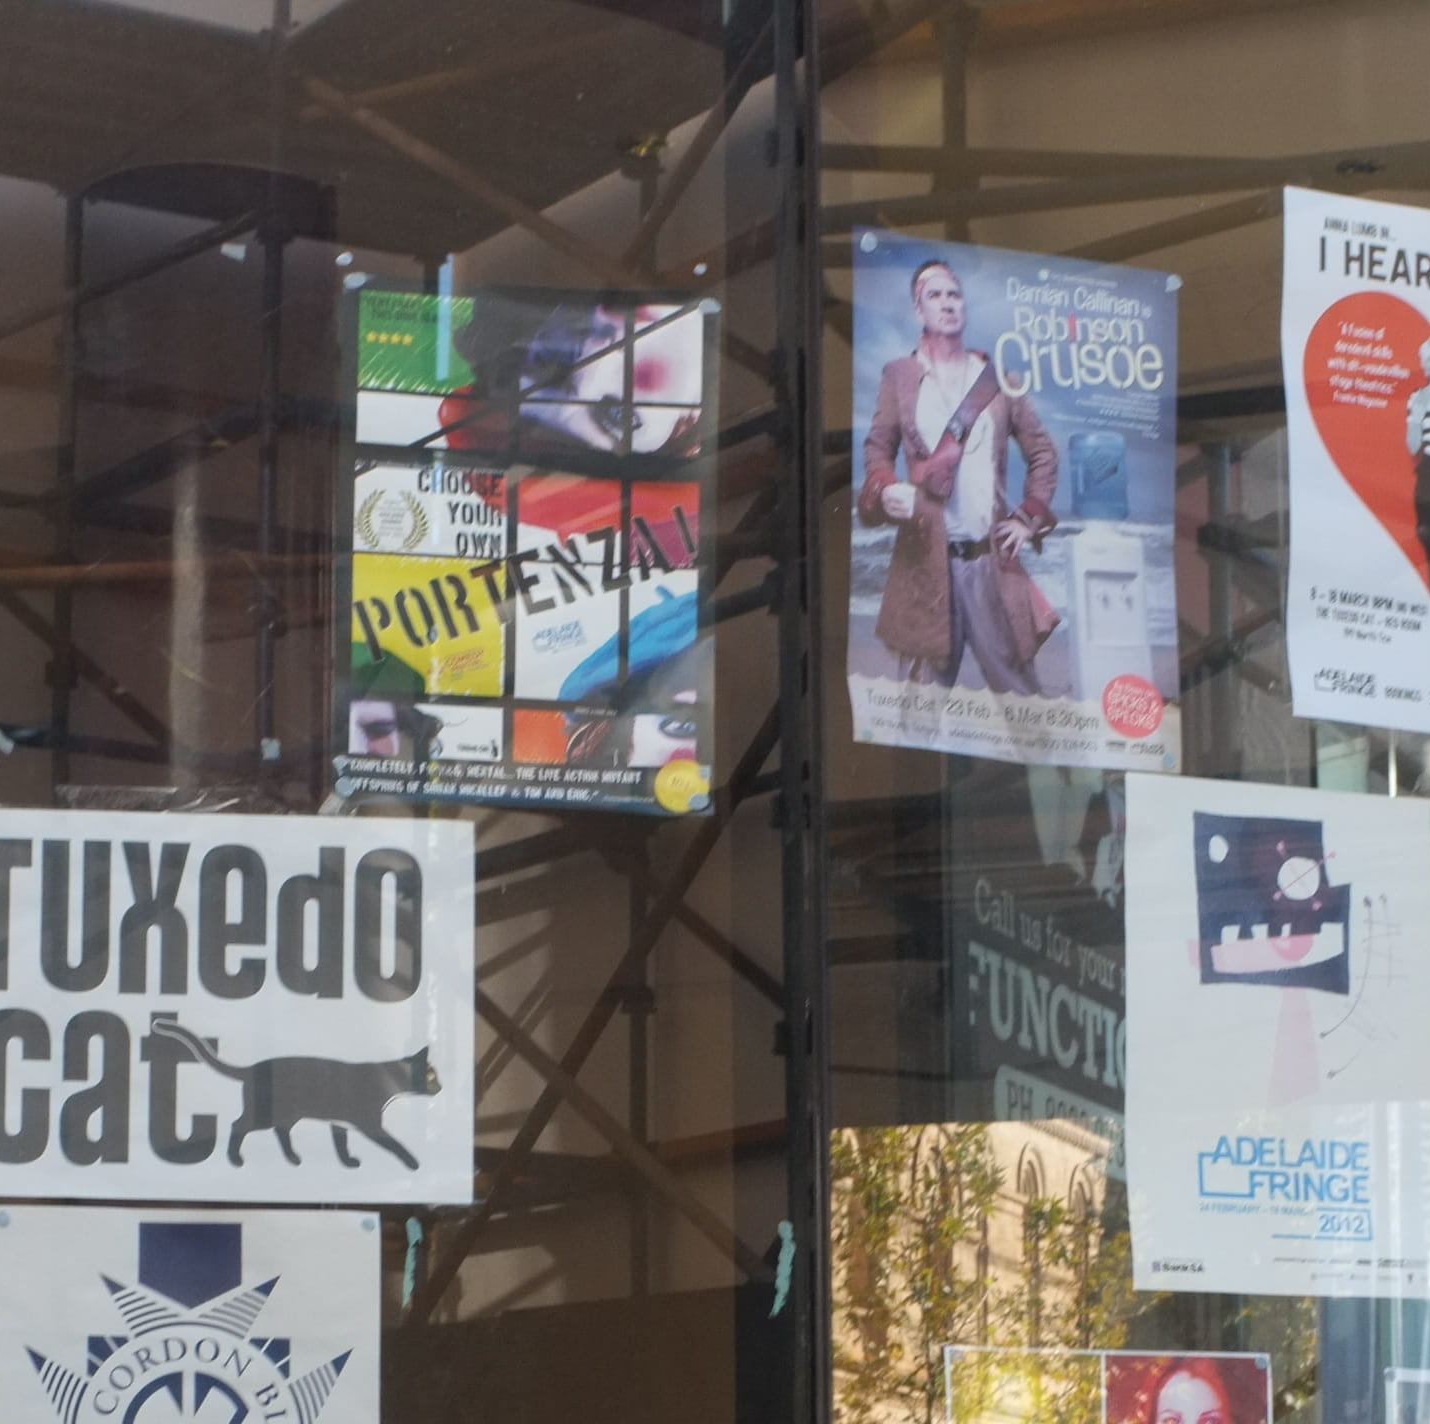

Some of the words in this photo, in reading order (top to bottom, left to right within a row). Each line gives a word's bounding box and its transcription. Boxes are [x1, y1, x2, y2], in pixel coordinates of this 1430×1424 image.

[1014, 307, 1144, 344] Robinson
[995, 332, 1164, 398] Crusoe
[417, 468, 504, 497] CHOOSE
[448, 501, 503, 526] YOUR
[455, 532, 503, 558] OWN
[975, 877, 1016, 940] Call
[1211, 1135, 1370, 1172] ADELAIDE
[1250, 1170, 1371, 1205] FRINGE
[1319, 1215, 1366, 1234] 2012
[93, 1336, 253, 1417] CORDON
